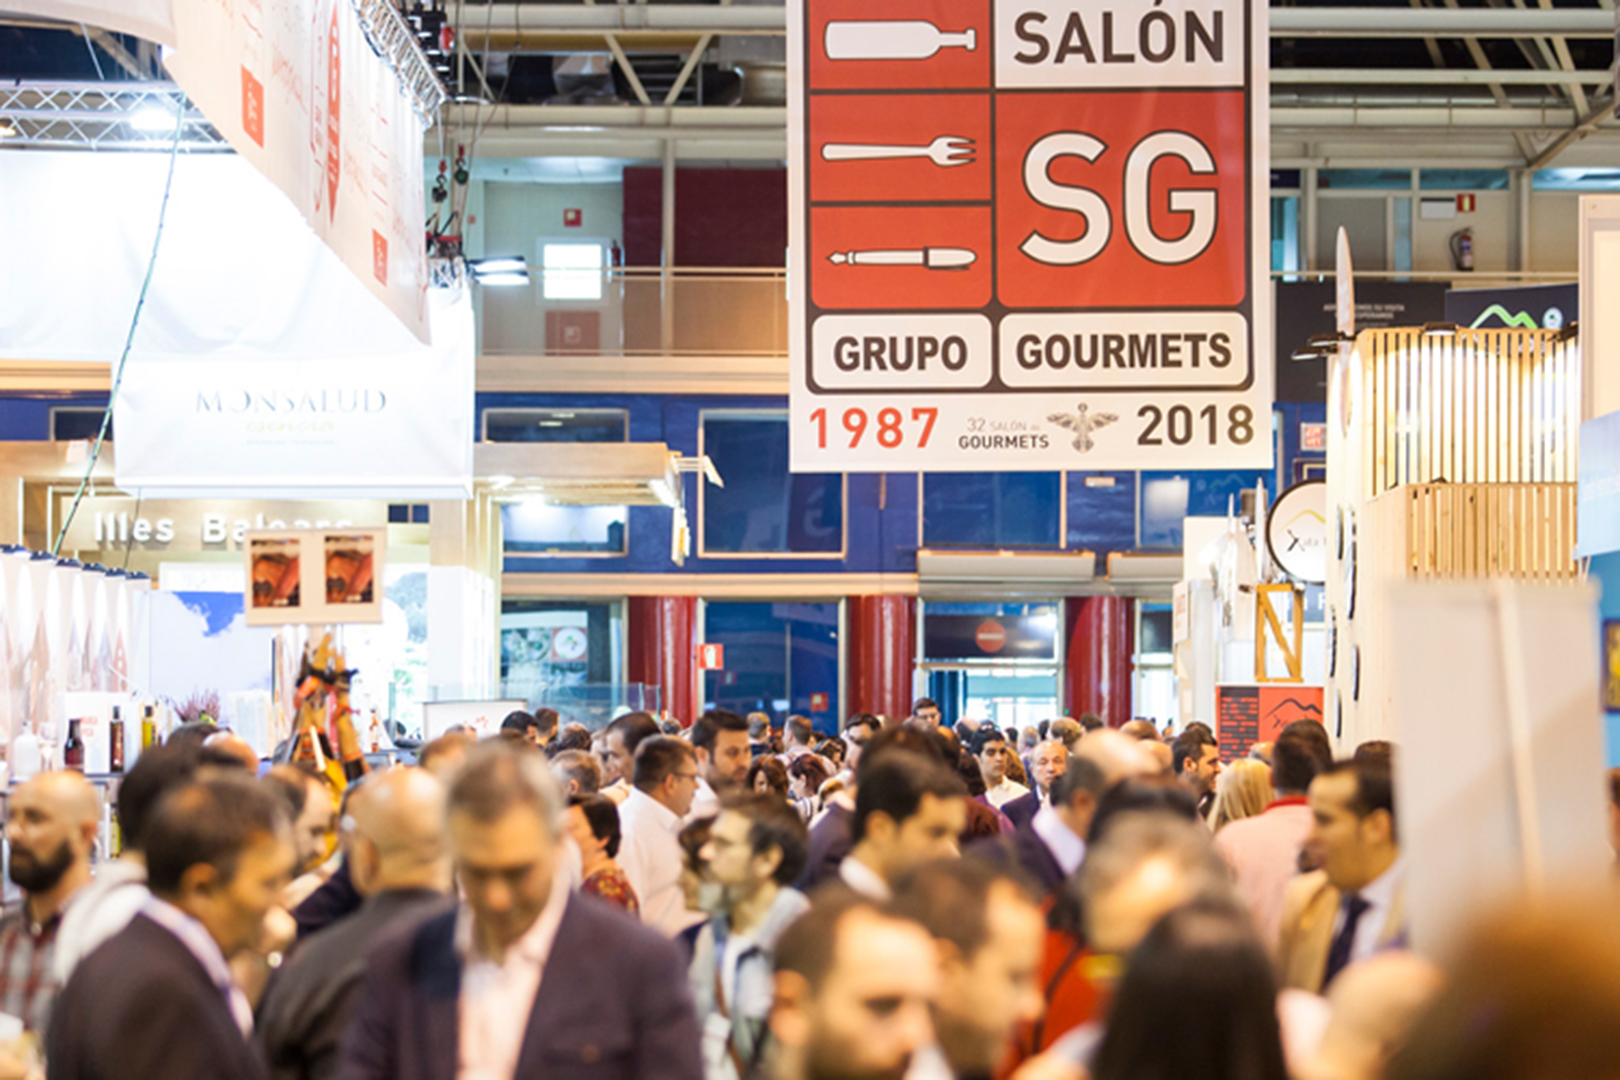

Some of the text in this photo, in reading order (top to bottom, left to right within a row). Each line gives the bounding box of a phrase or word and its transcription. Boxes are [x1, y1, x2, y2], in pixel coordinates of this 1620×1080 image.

[1014, 0, 1223, 64] SALÓN
[1018, 129, 1219, 266] SG
[834, 332, 1232, 372] GRUPO GOURMETS
[195, 388, 387, 412] MONSALUD
[810, 407, 939, 449] 1987
[958, 434, 1050, 450] GOURMETS
[967, 416, 986, 432] 32
[1137, 404, 1254, 446] 2018
[94, 512, 175, 542] Illes
